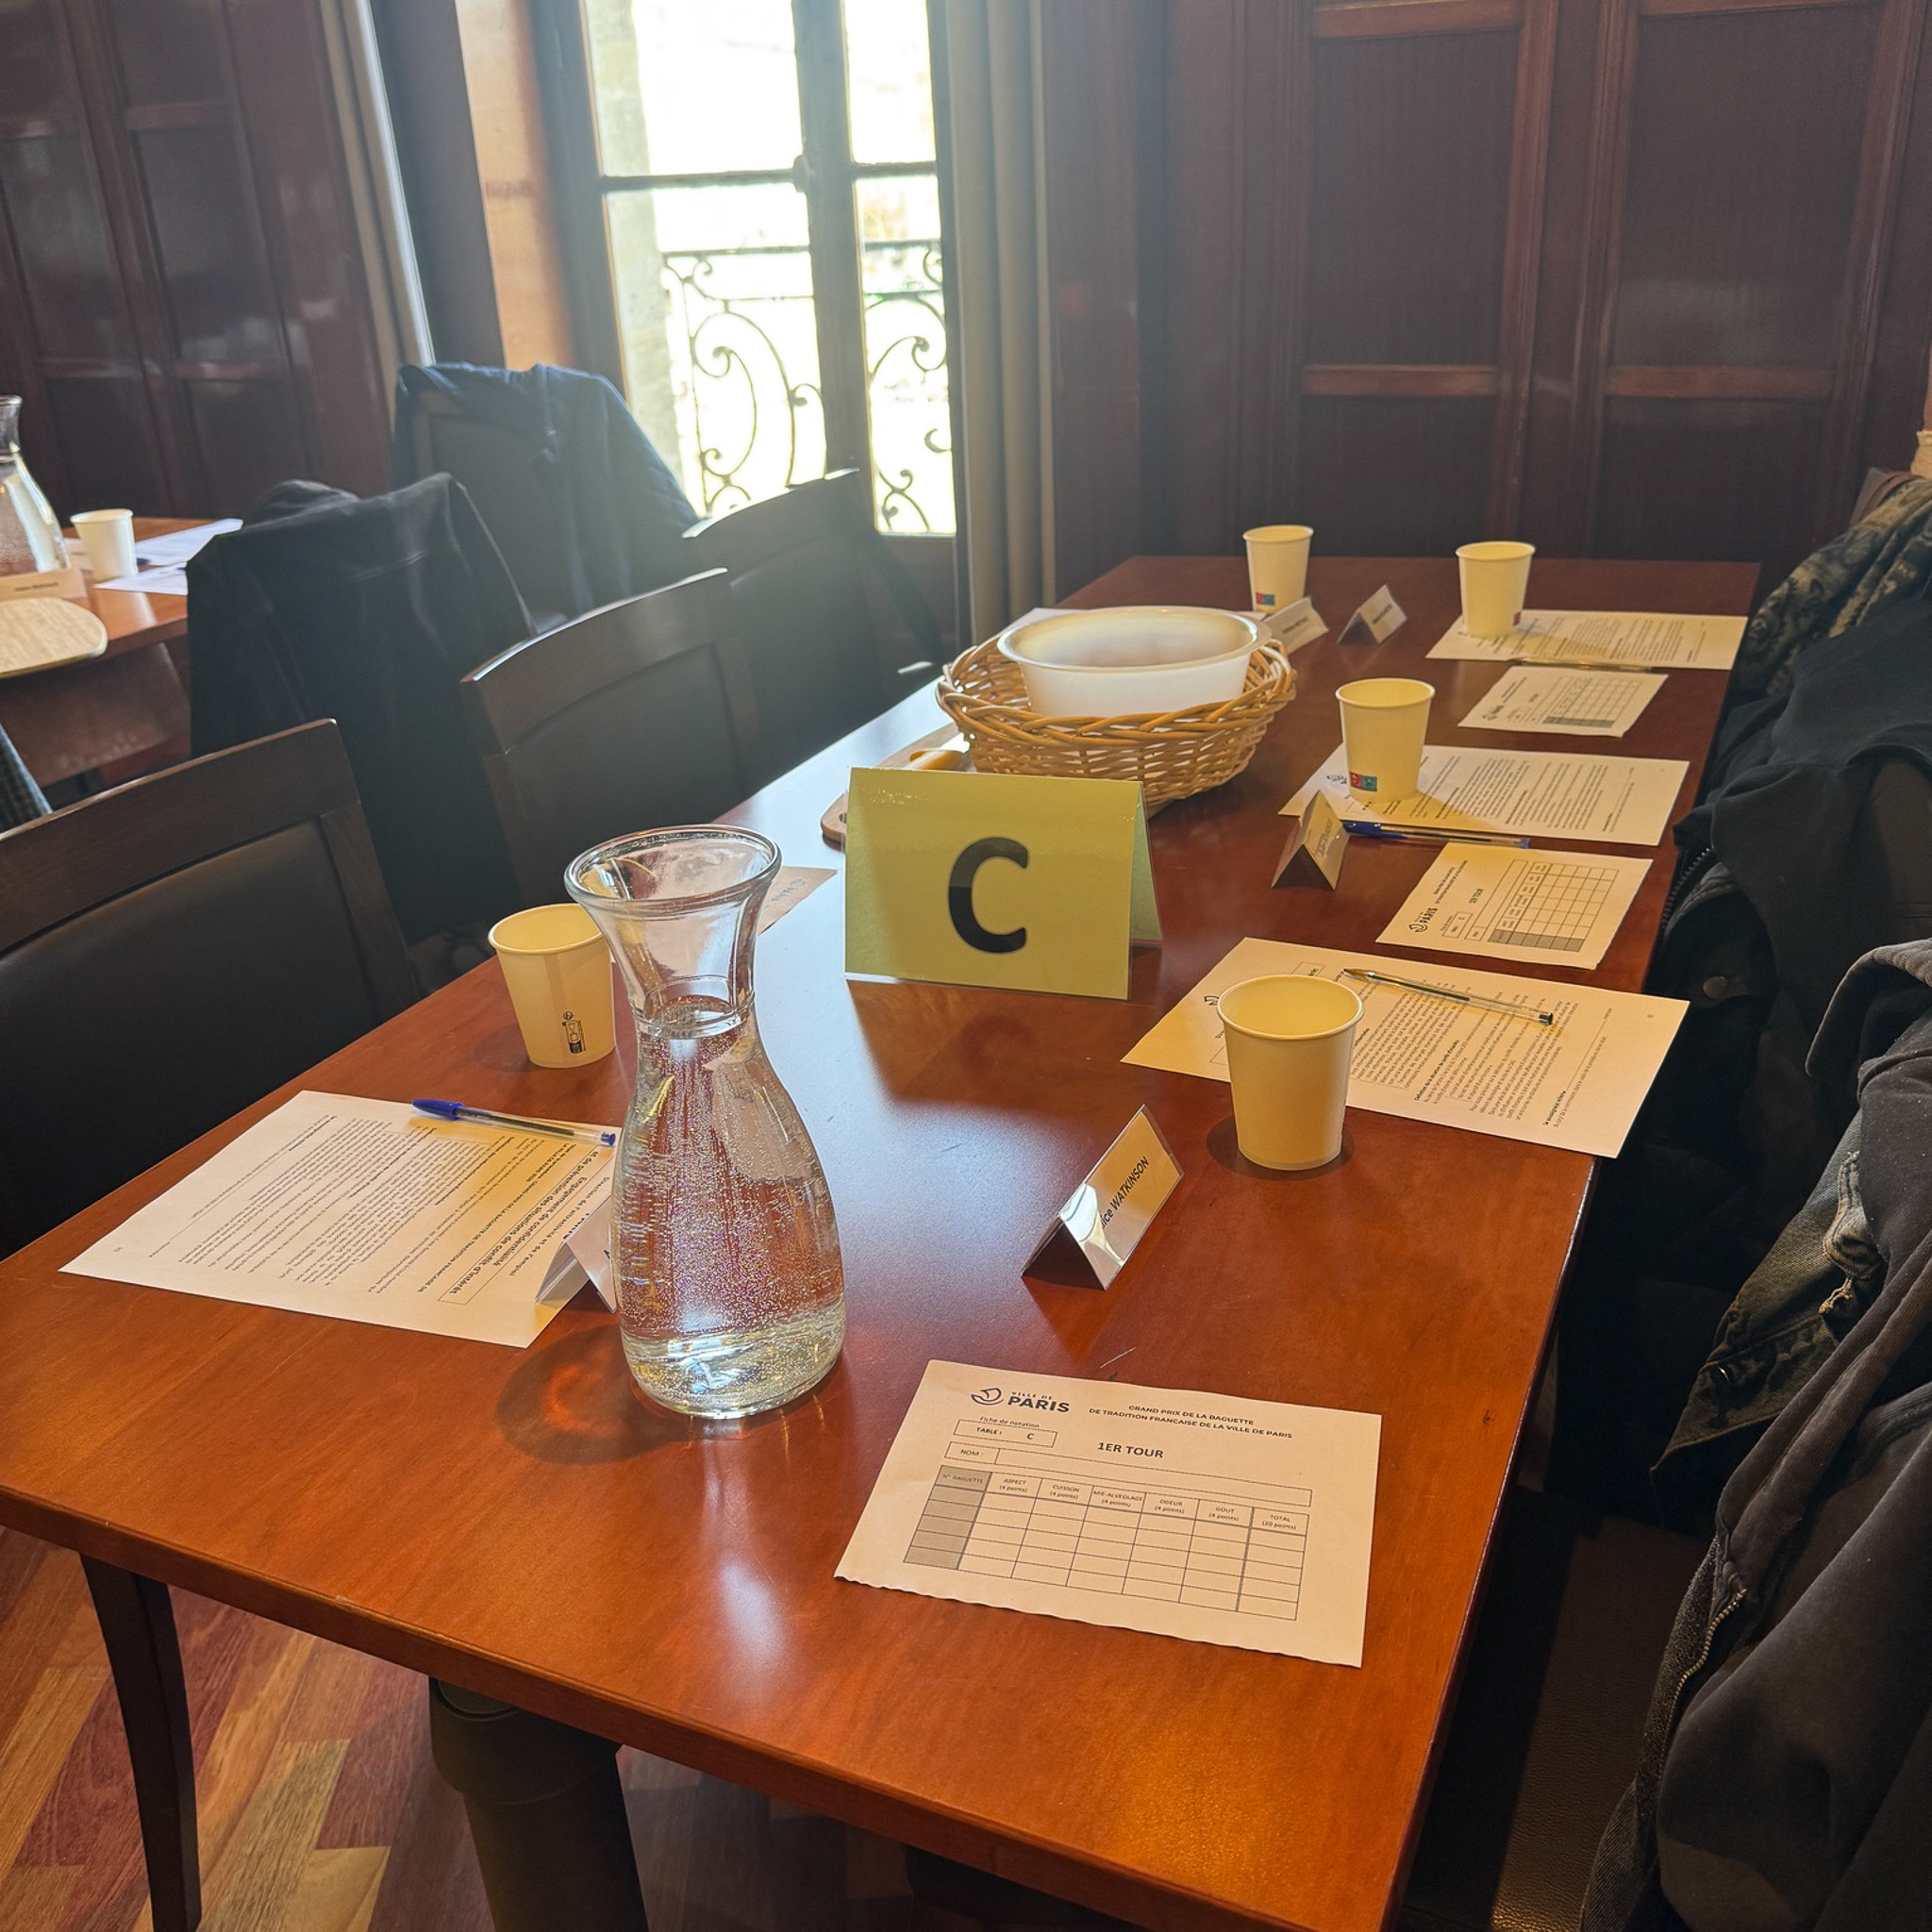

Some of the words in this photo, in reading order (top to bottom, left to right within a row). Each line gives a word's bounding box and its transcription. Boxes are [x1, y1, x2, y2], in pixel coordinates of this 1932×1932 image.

[948, 837, 1028, 955] C
[547, 1177, 587, 1212] Engagement
[1109, 1155, 1149, 1211] WATKINSON
[1008, 1395, 1070, 1413] PARIS
[1128, 1405, 1159, 1413] GRAND
[1209, 1414, 1255, 1426] BAGUETTE
[976, 1426, 998, 1435] TABLE
[1103, 1409, 1148, 1421] TRADITION
[1226, 1424, 1251, 1434] VILLE
[1266, 1430, 1293, 1439] PARIS
[1096, 1441, 1123, 1453] 1ER
[1125, 1445, 1164, 1458] TOUR
